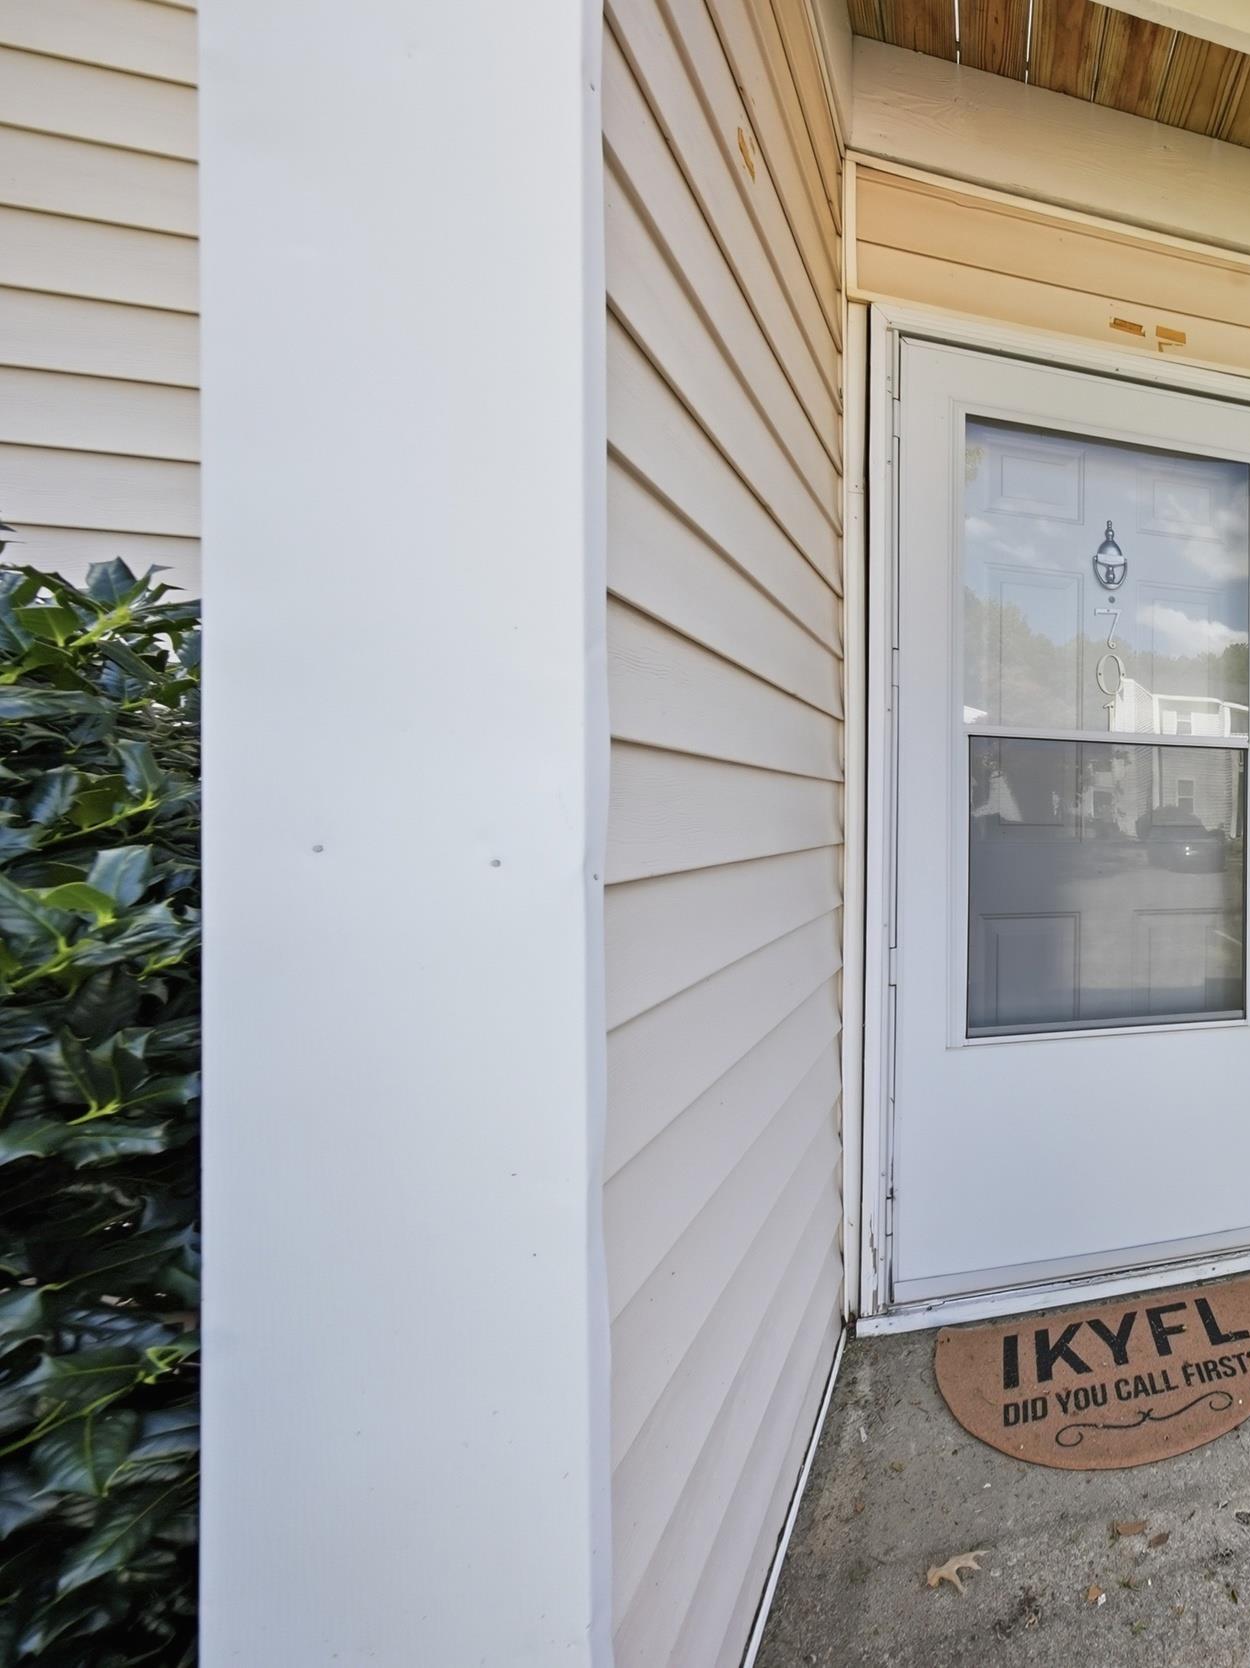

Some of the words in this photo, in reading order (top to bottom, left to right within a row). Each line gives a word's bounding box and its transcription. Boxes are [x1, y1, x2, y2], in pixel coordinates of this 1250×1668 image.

[1003, 1298, 1250, 1389] IKYFL
[1004, 1397, 1048, 1427] DID
[1056, 1385, 1108, 1414] YOU
[1115, 1370, 1179, 1401] CALL
